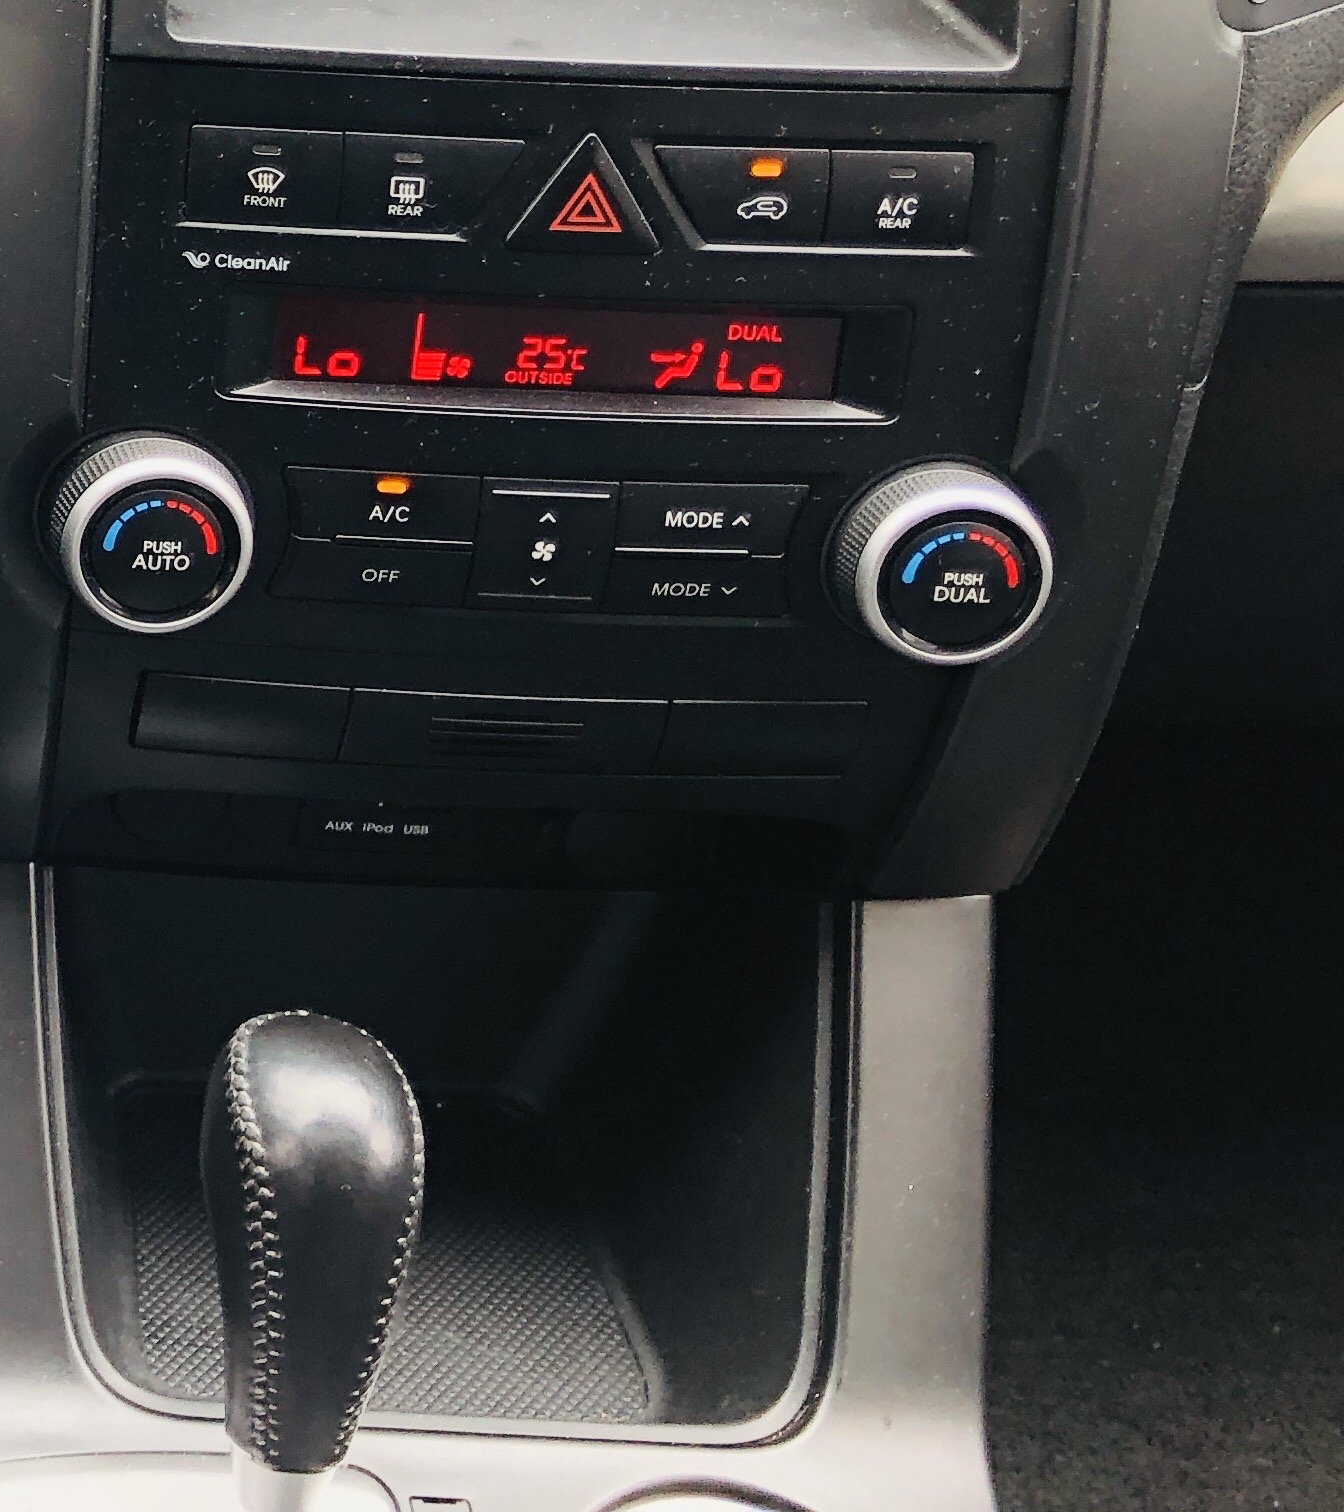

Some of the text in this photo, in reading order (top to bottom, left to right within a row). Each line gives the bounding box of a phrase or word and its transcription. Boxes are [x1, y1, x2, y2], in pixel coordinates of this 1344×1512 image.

[244, 194, 287, 208] FRONT
[877, 197, 919, 216] A/C
[387, 204, 423, 217] REAR
[878, 217, 911, 229] REAR
[214, 254, 291, 272] CleanAir
[728, 324, 783, 343] DUAL
[294, 335, 360, 377] Lo
[505, 371, 573, 385] OUTSIDE
[716, 350, 783, 393] Lo
[369, 505, 410, 524] A/C
[664, 510, 724, 529] MODE
[143, 540, 182, 555] PUSH
[132, 554, 190, 572] AUTO
[362, 569, 400, 583] OFF
[944, 571, 984, 587] PUSH
[651, 582, 711, 597] MODE
[933, 586, 991, 604] DUAL
[325, 821, 353, 832] AUX
[403, 824, 429, 835] USB
